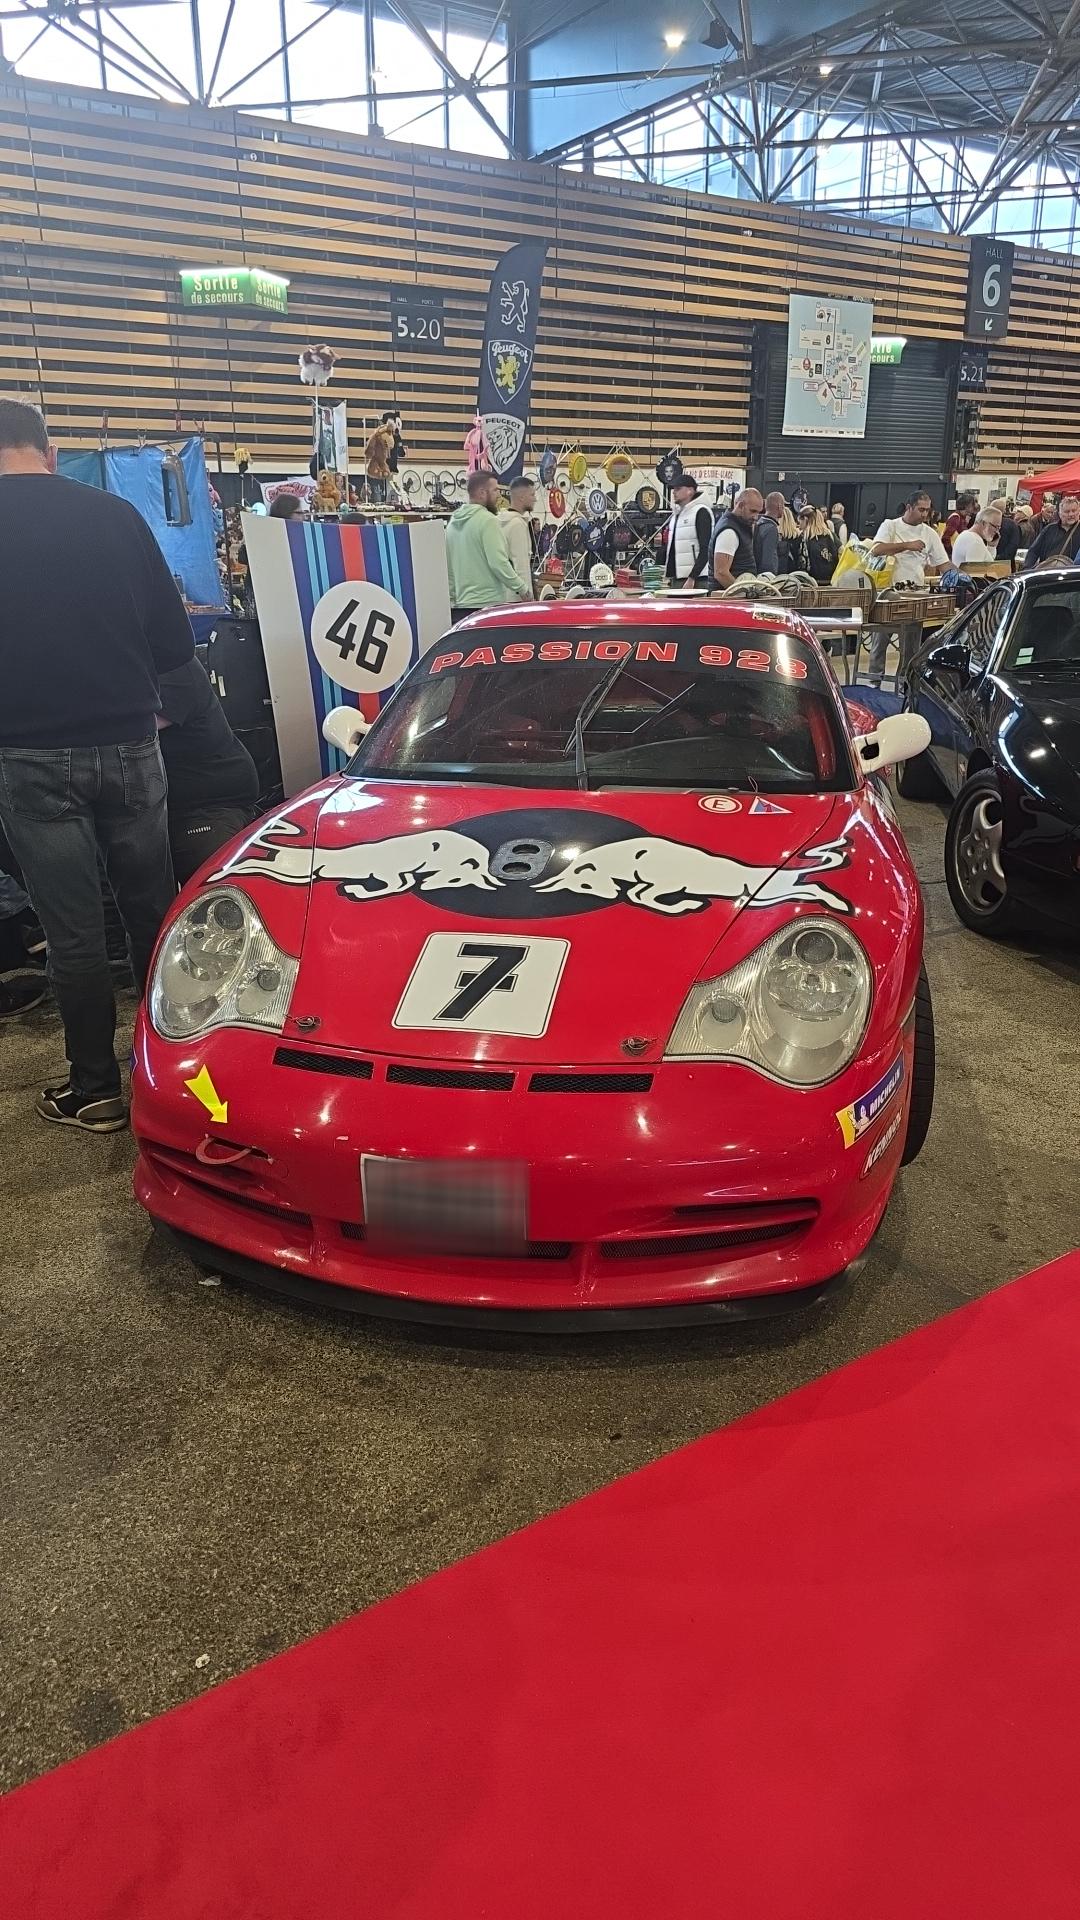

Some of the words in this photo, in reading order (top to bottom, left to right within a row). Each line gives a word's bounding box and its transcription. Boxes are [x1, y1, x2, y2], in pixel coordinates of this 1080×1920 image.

[985, 246, 1003, 259] HALL
[193, 275, 238, 291] Sortie
[257, 277, 281, 299] Sortie
[982, 264, 1001, 307] 6
[191, 291, 203, 304] de
[204, 291, 244, 305] secours
[397, 315, 441, 341] 5.20
[826, 312, 832, 322] 7
[491, 341, 529, 363] Peugeot
[960, 365, 985, 383] 5.21
[821, 388, 828, 399] 4
[485, 417, 521, 430] PEUGEOT
[325, 599, 395, 675] 46
[429, 640, 679, 674] PASSION
[699, 645, 808, 679] 928
[712, 799, 727, 809] E
[488, 838, 555, 881] 8
[432, 941, 530, 1022] 7
[869, 1065, 901, 1117] MICHELIN
